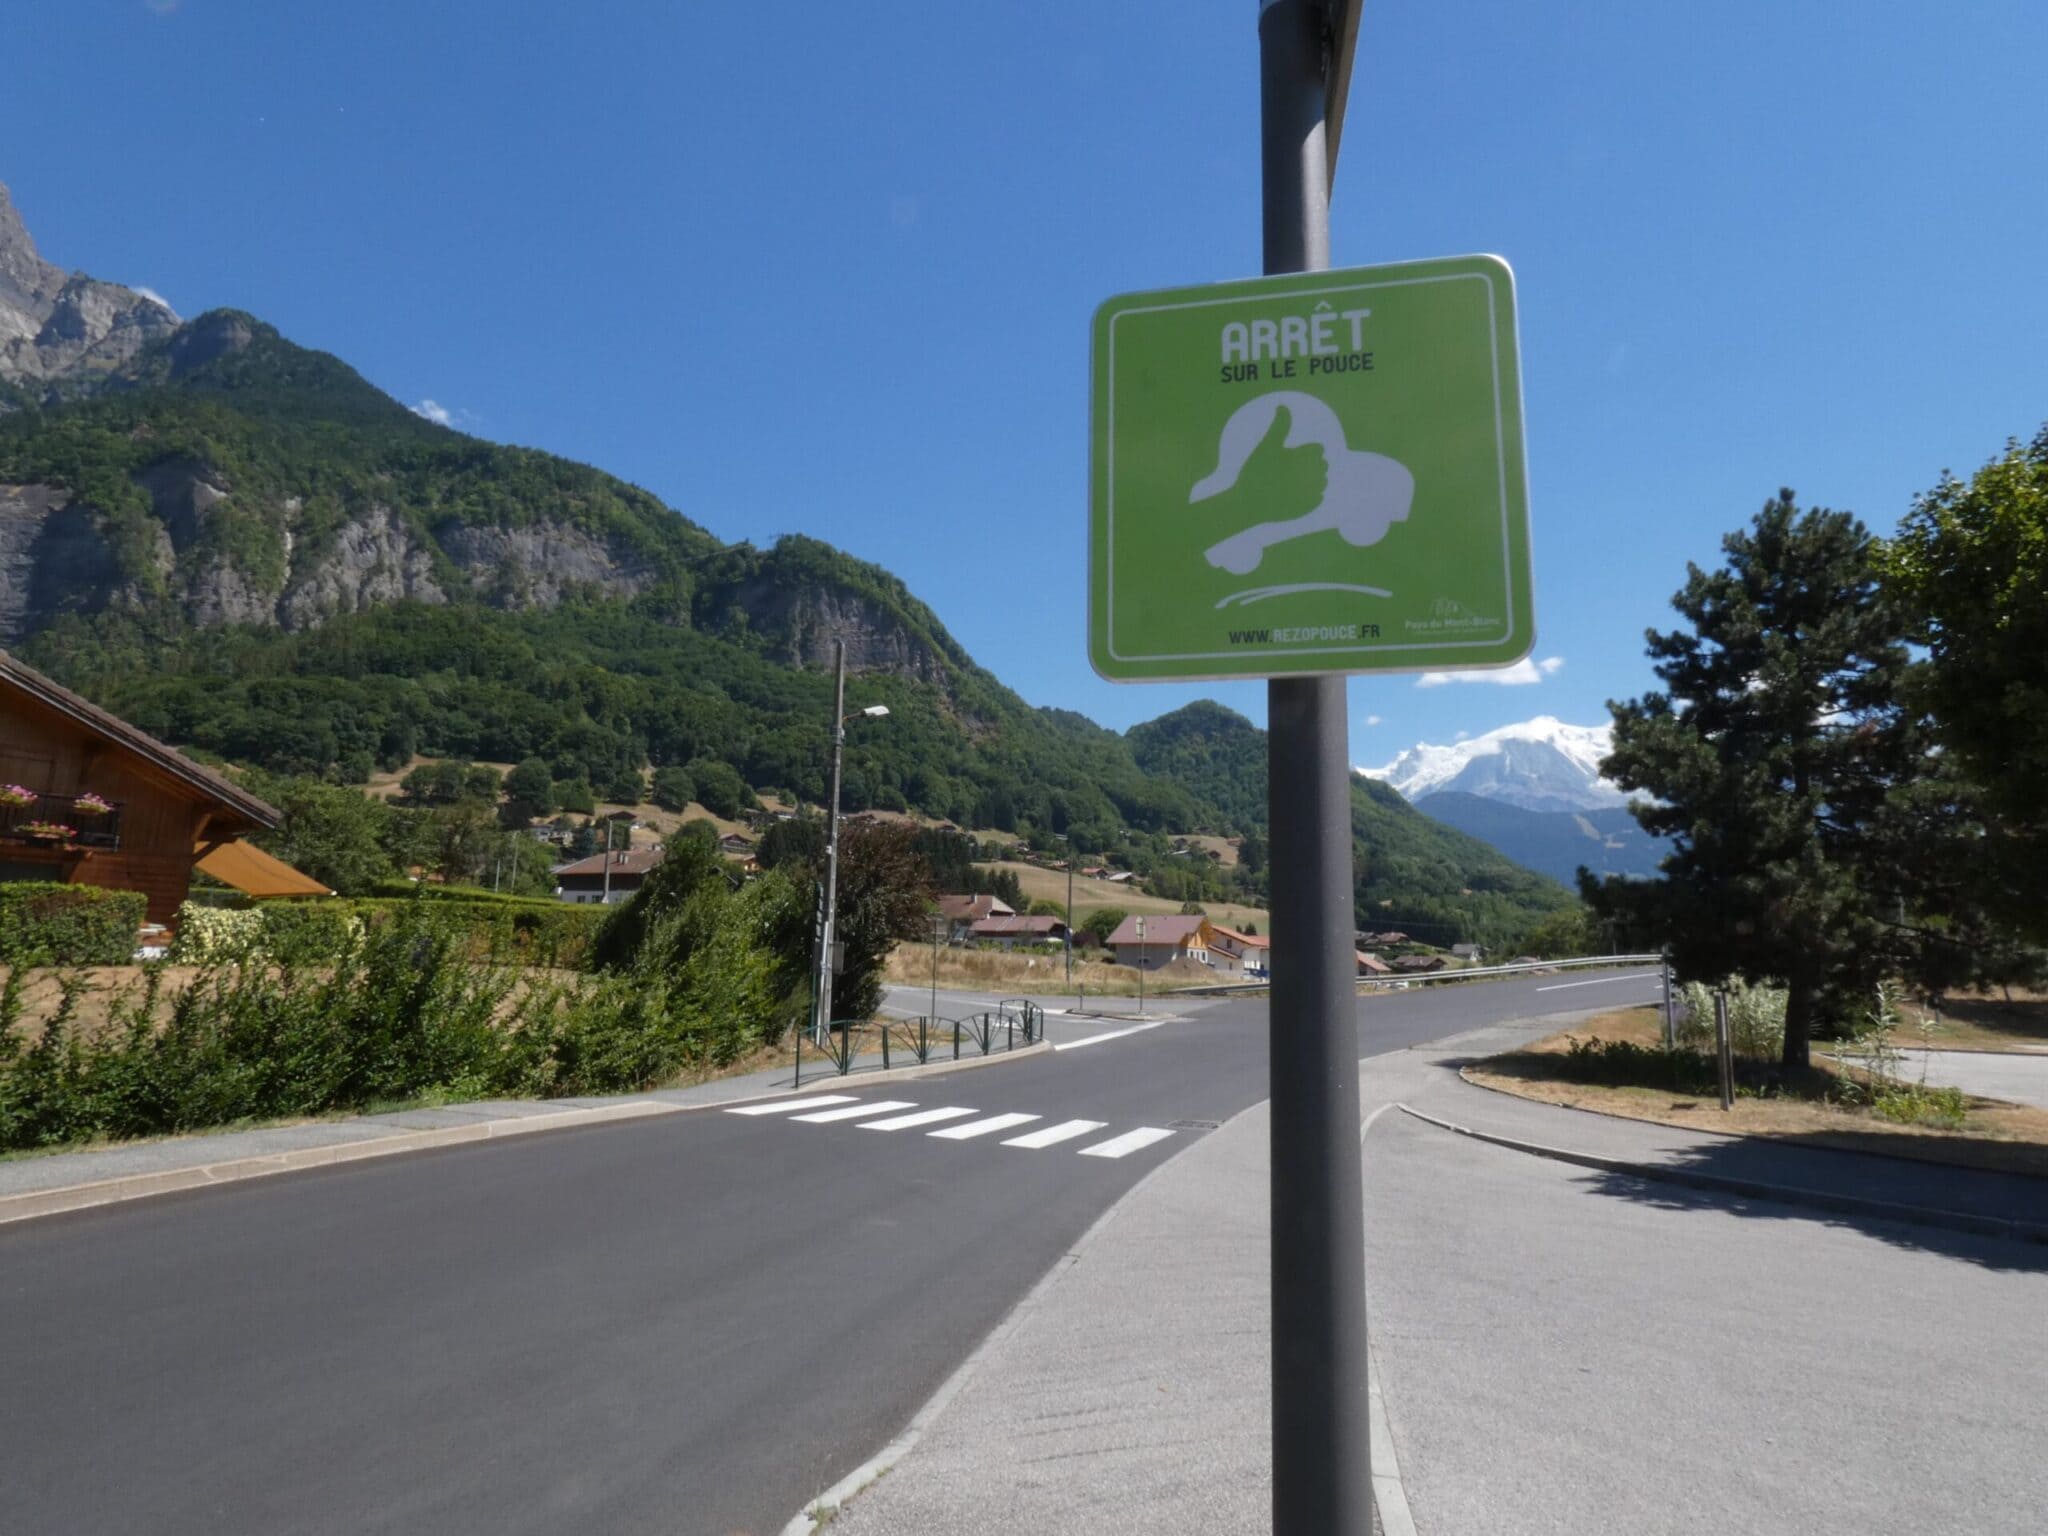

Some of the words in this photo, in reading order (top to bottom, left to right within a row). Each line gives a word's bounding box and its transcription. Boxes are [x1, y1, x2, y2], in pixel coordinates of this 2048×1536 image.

[1221, 301, 1371, 363] ARRÊT
[1221, 364, 1258, 383] SUR
[1271, 360, 1296, 378] LE
[1310, 353, 1374, 375] POUCE
[1229, 624, 1380, 643] WWW.REZOPOUCE.FR
